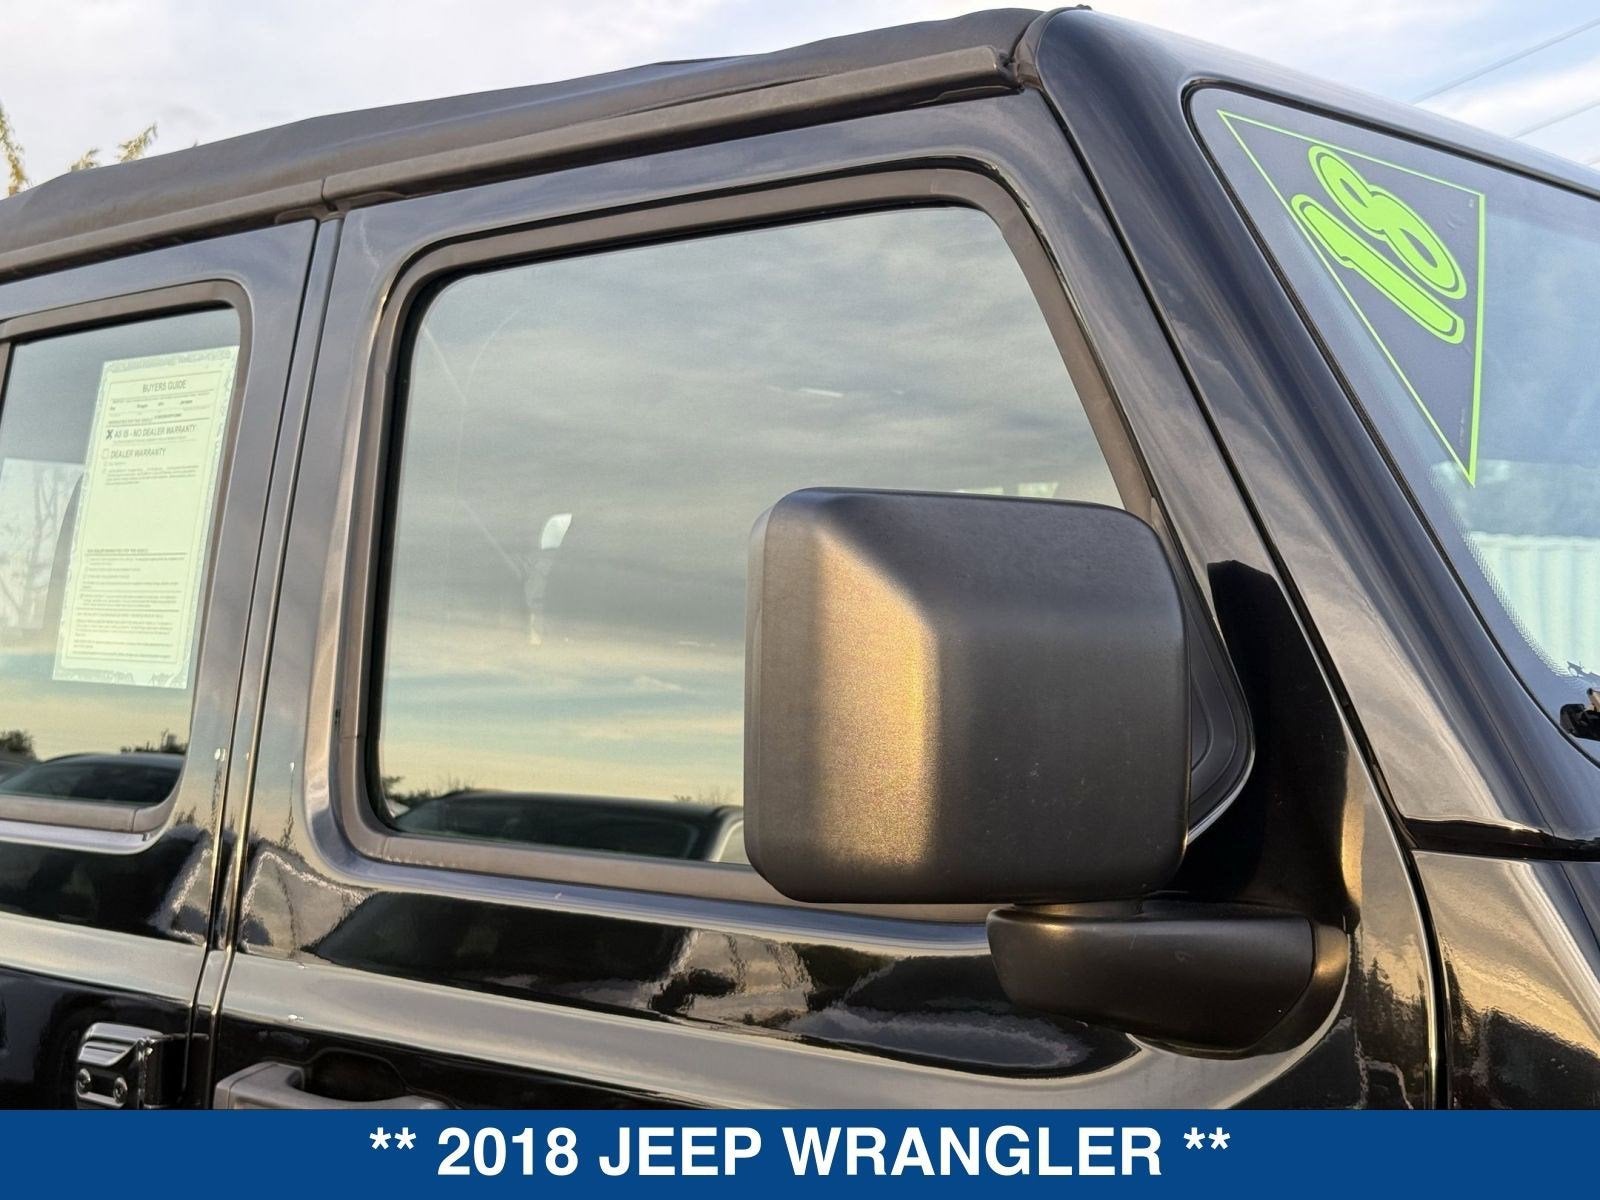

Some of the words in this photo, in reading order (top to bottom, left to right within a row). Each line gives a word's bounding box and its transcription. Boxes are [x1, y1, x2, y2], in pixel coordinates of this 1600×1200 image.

[1291, 146, 1467, 344] 18
[142, 382, 167, 393] BUYERS
[167, 380, 187, 391] GUIDE
[114, 429, 121, 438] AS
[133, 428, 142, 437] NO
[142, 426, 165, 437] DEALER
[165, 424, 197, 434] WARRANTY
[110, 449, 133, 459] DEALER
[134, 447, 167, 457] WARRANTY
